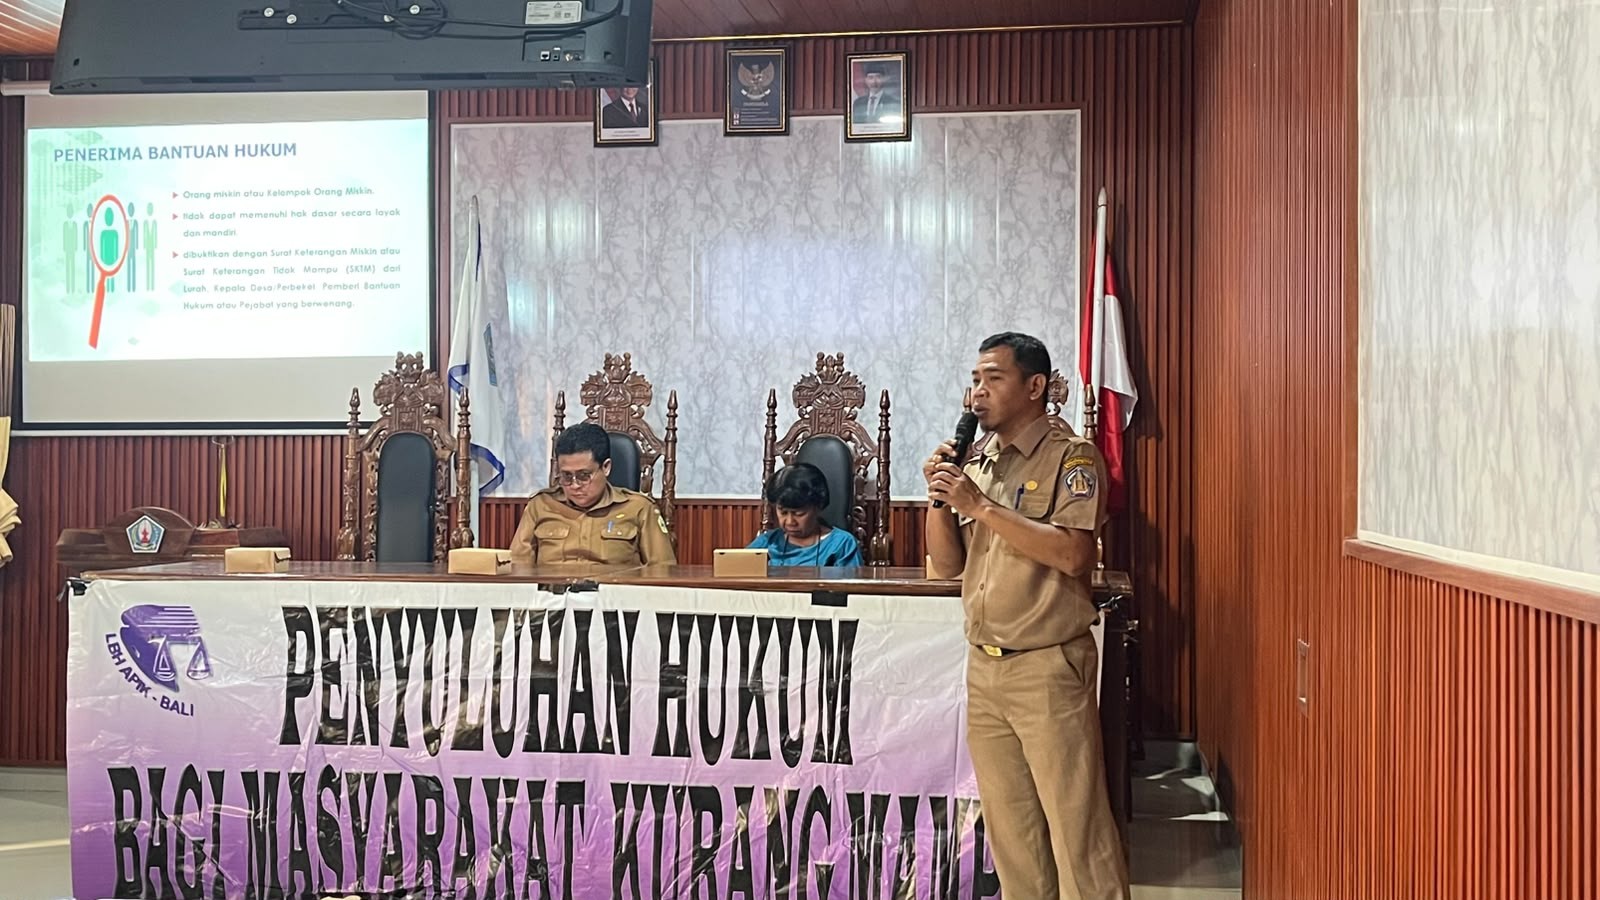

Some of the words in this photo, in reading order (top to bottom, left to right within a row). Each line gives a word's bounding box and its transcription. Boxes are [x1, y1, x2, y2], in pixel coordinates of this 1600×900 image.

[53, 148, 143, 162] PENERIMA
[148, 145, 229, 160] BANTUAN
[234, 142, 297, 158] HUKUM
[183, 191, 211, 201] Orang
[213, 191, 240, 199] miskin
[244, 190, 264, 198] atau
[314, 188, 342, 198] Orang
[209, 212, 236, 221] dapat
[240, 210, 287, 219] memenuhi
[291, 210, 307, 218] hak
[311, 210, 337, 218] dasar
[375, 208, 400, 217] layak
[183, 230, 200, 238] dan
[232, 250, 268, 260] dengan
[270, 249, 292, 257] Surat
[295, 249, 347, 258] Keterangan
[350, 248, 377, 256] Miskin
[380, 248, 400, 256] atau
[183, 268, 205, 277] Surat
[213, 268, 265, 277] Keterangan
[273, 266, 295, 275] Tidak
[304, 266, 338, 275] Mampu
[346, 265, 376, 275] (SKTM)
[383, 264, 400, 273] dari
[214, 283, 245, 294] Kepala
[364, 282, 400, 291] Bantuan
[183, 302, 213, 311] Hukum
[216, 302, 236, 310] atau
[240, 301, 274, 311] Pejabat
[276, 302, 298, 310] yang
[105, 633, 126, 666] LBH
[119, 666, 152, 698] APIK
[159, 695, 195, 717] BALI
[279, 605, 640, 758] PENYULUHAN
[651, 611, 859, 768] HUKUM
[107, 763, 225, 900] BAGI
[240, 763, 586, 900] MASYARAKAT
[610, 784, 838, 900] KURANG
